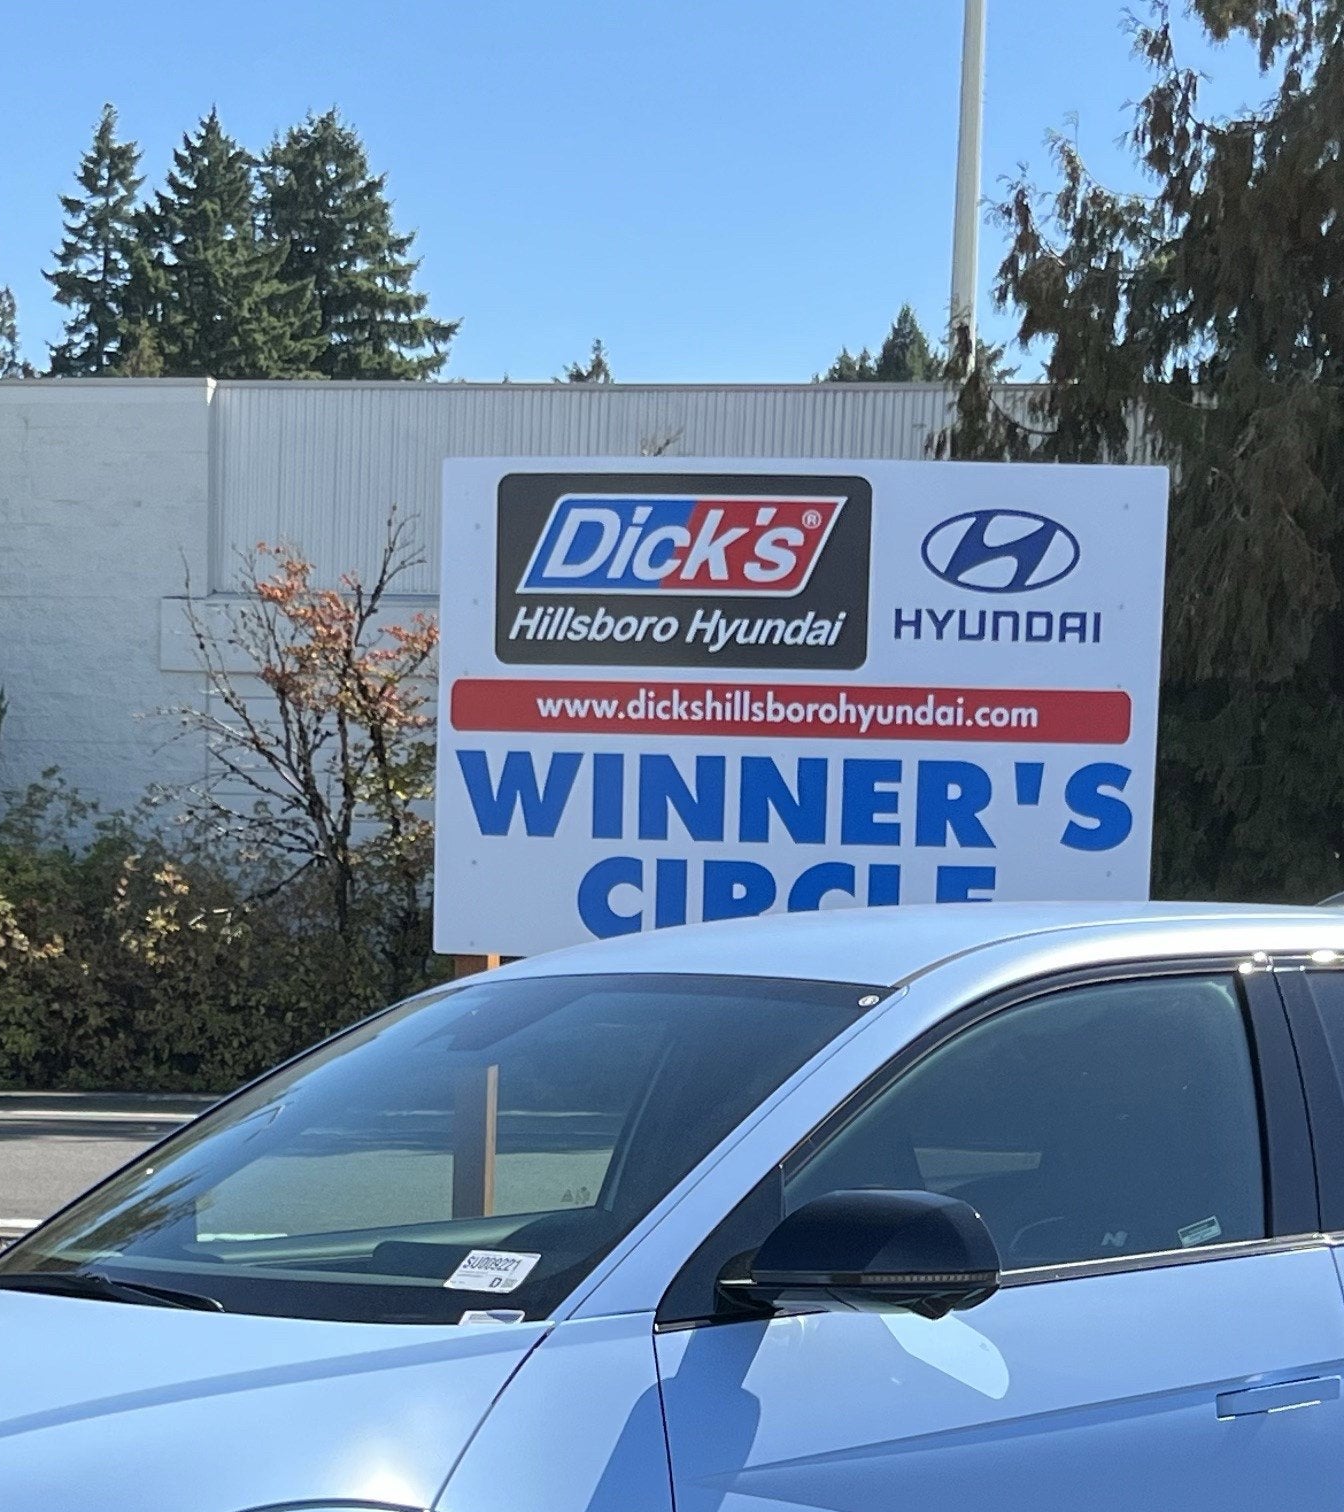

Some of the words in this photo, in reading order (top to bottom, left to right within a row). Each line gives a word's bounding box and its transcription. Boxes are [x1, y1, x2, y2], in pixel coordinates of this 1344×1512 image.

[508, 607, 676, 645] Hillsboro
[685, 608, 847, 653] Hyundai
[893, 608, 1102, 643] HYUNDAI
[537, 688, 1040, 734] www.dickshillsborohyundai.com
[456, 749, 1134, 851] WINNER'S
